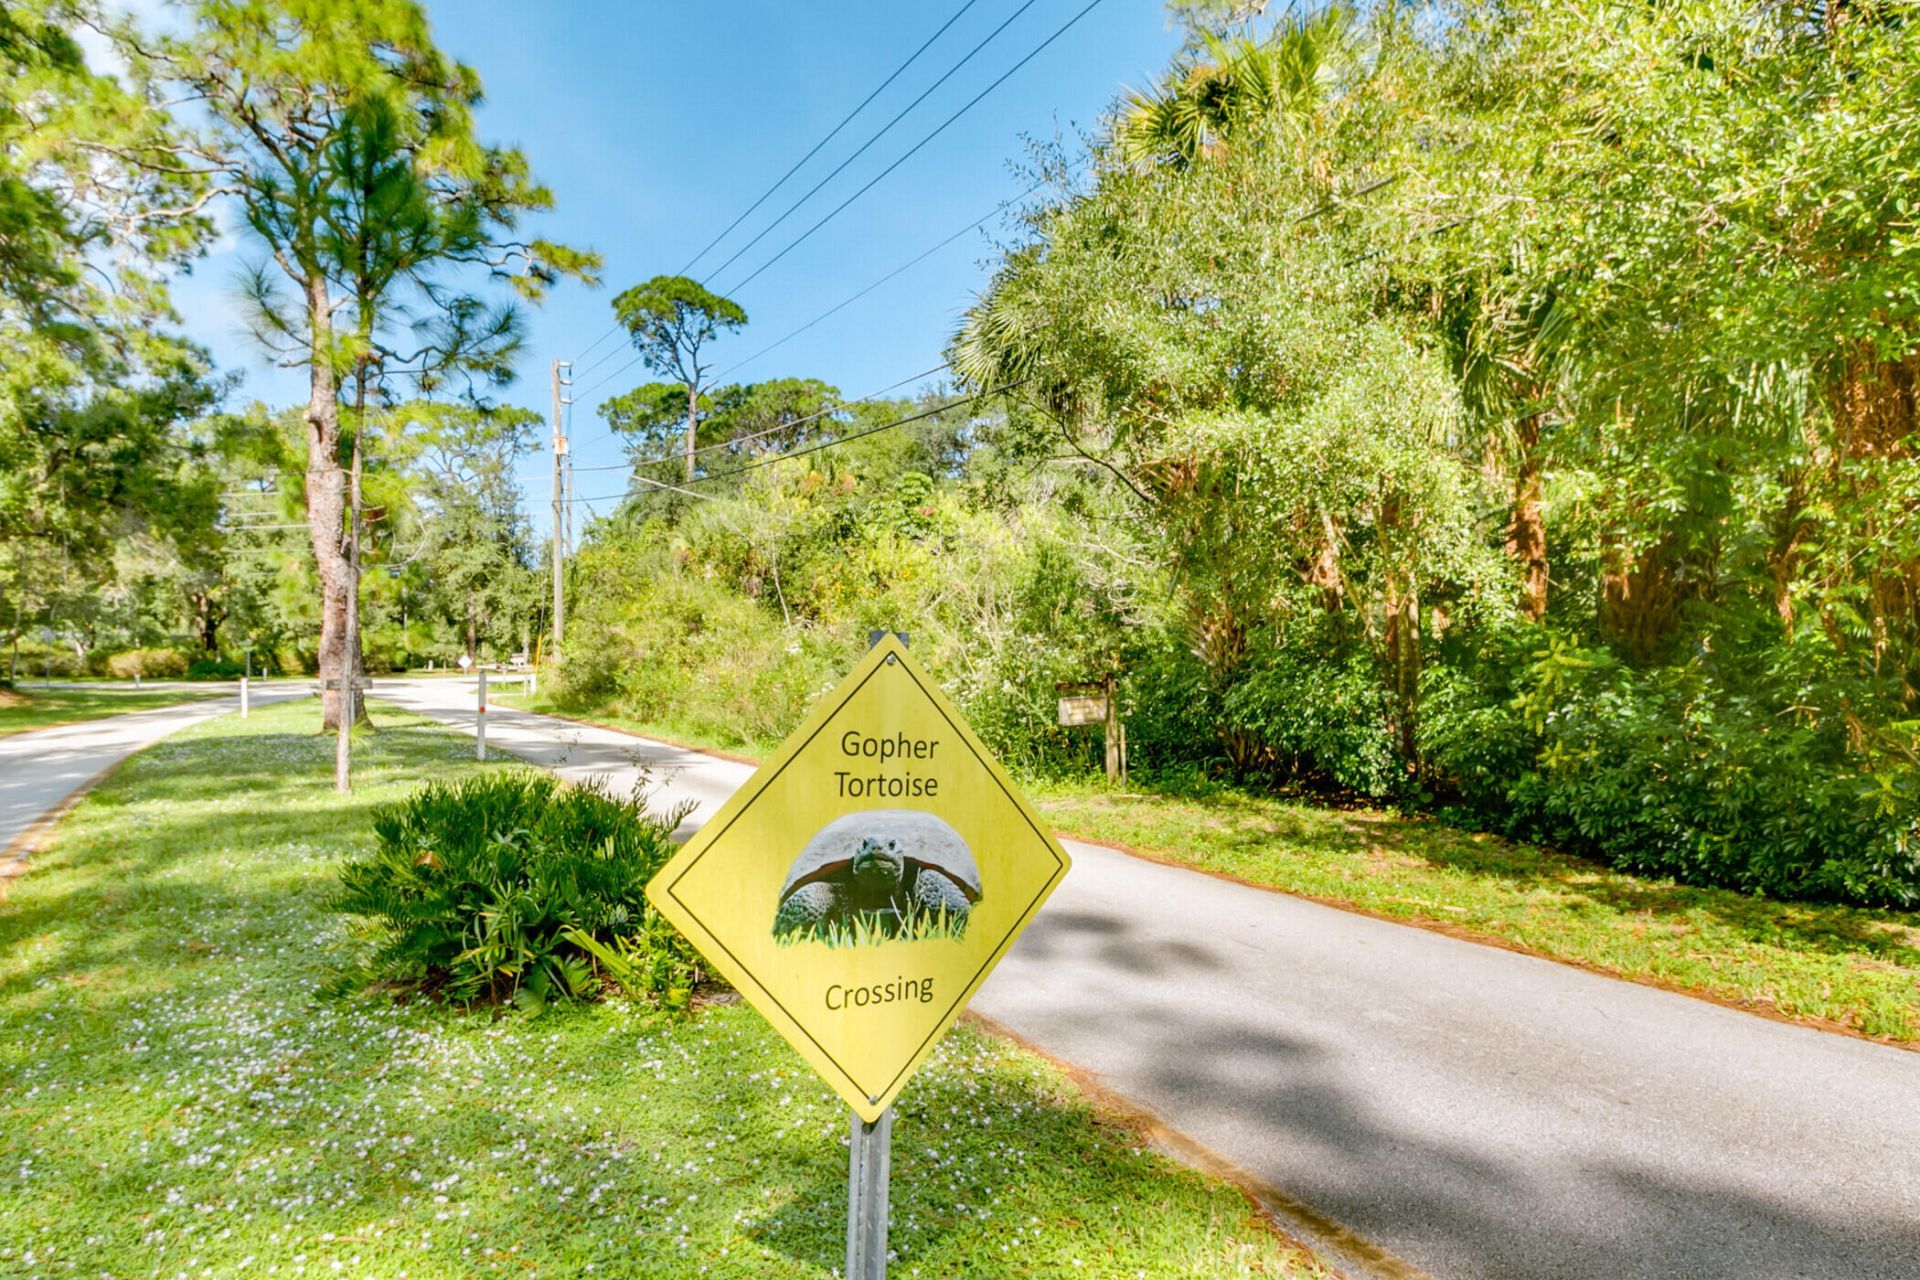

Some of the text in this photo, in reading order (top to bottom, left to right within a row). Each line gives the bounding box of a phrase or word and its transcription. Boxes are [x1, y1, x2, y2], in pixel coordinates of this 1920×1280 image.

[841, 730, 940, 763] Gopher
[834, 771, 938, 798] Tortoise
[825, 975, 934, 1010] Crossing
